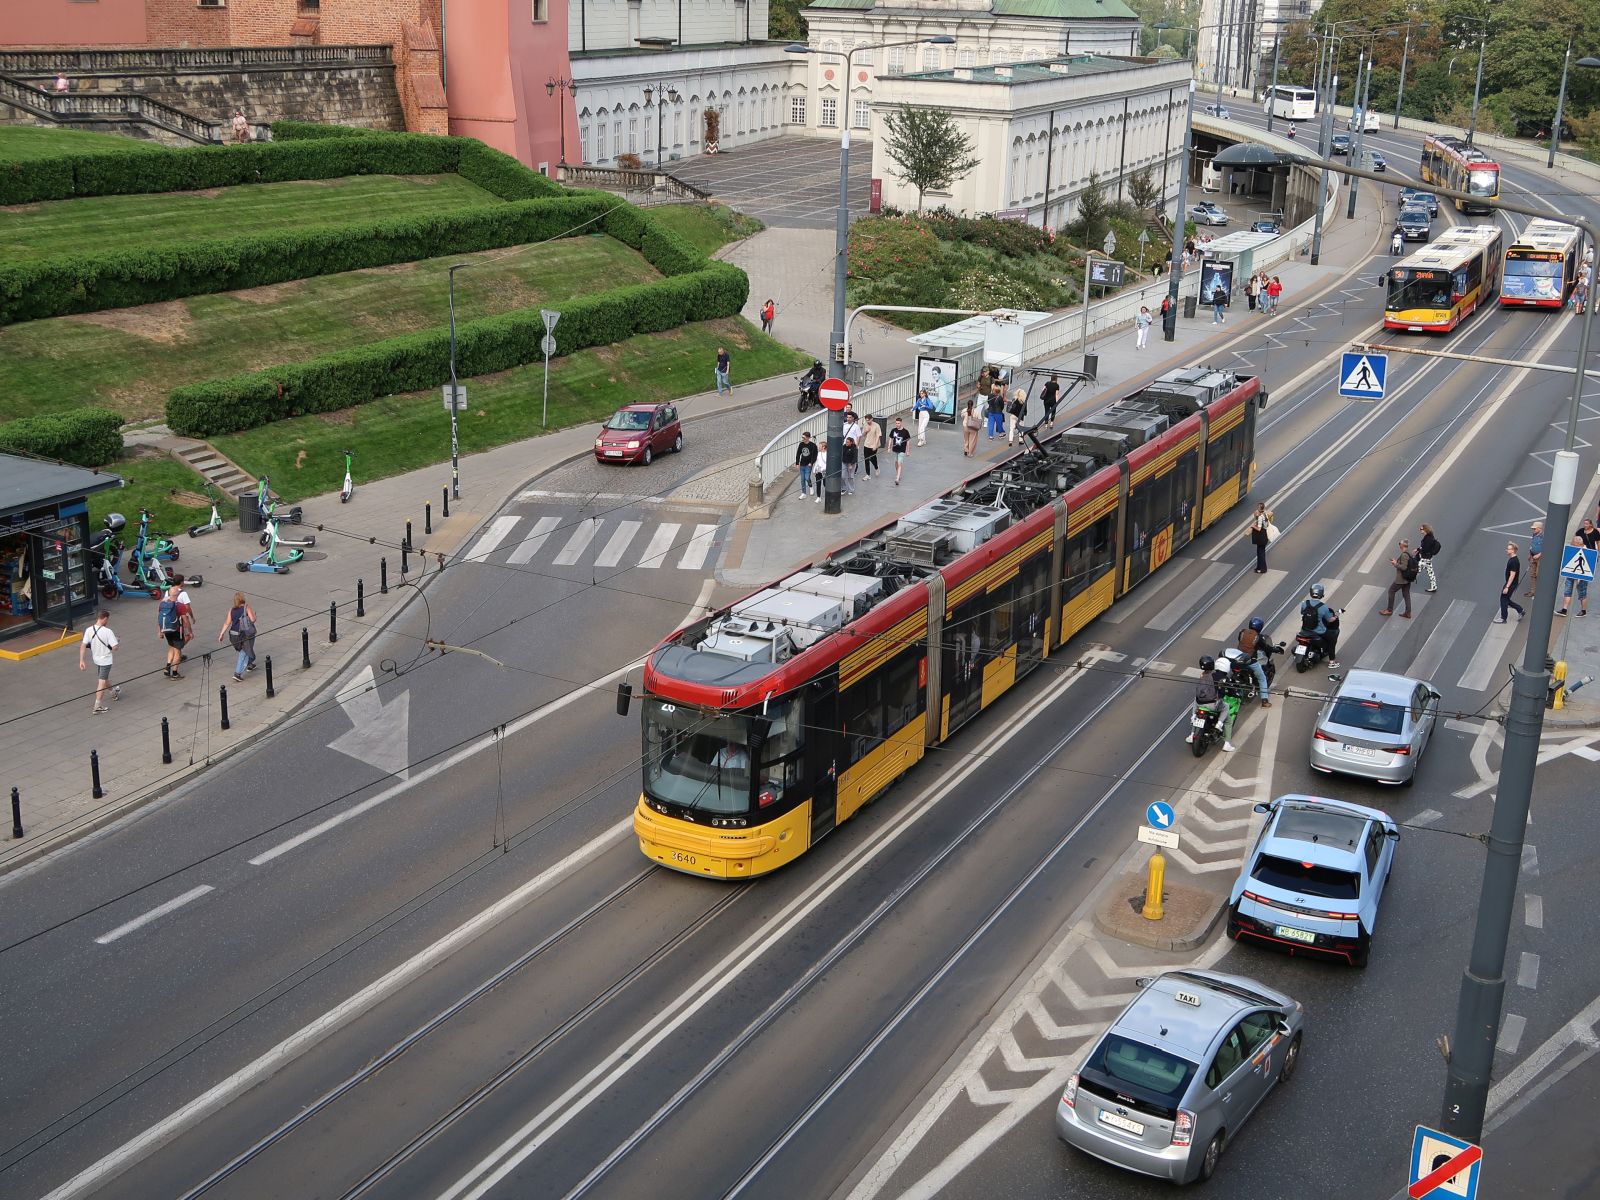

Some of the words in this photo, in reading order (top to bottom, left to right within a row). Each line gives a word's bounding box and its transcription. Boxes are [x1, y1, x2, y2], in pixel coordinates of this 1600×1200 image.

[671, 850, 696, 865] 3640
[1280, 927, 1290, 936] WB
[1291, 930, 1313, 942] 6582Y
[1179, 993, 1196, 1004] TAXI
[1452, 1104, 1460, 1114] 2
